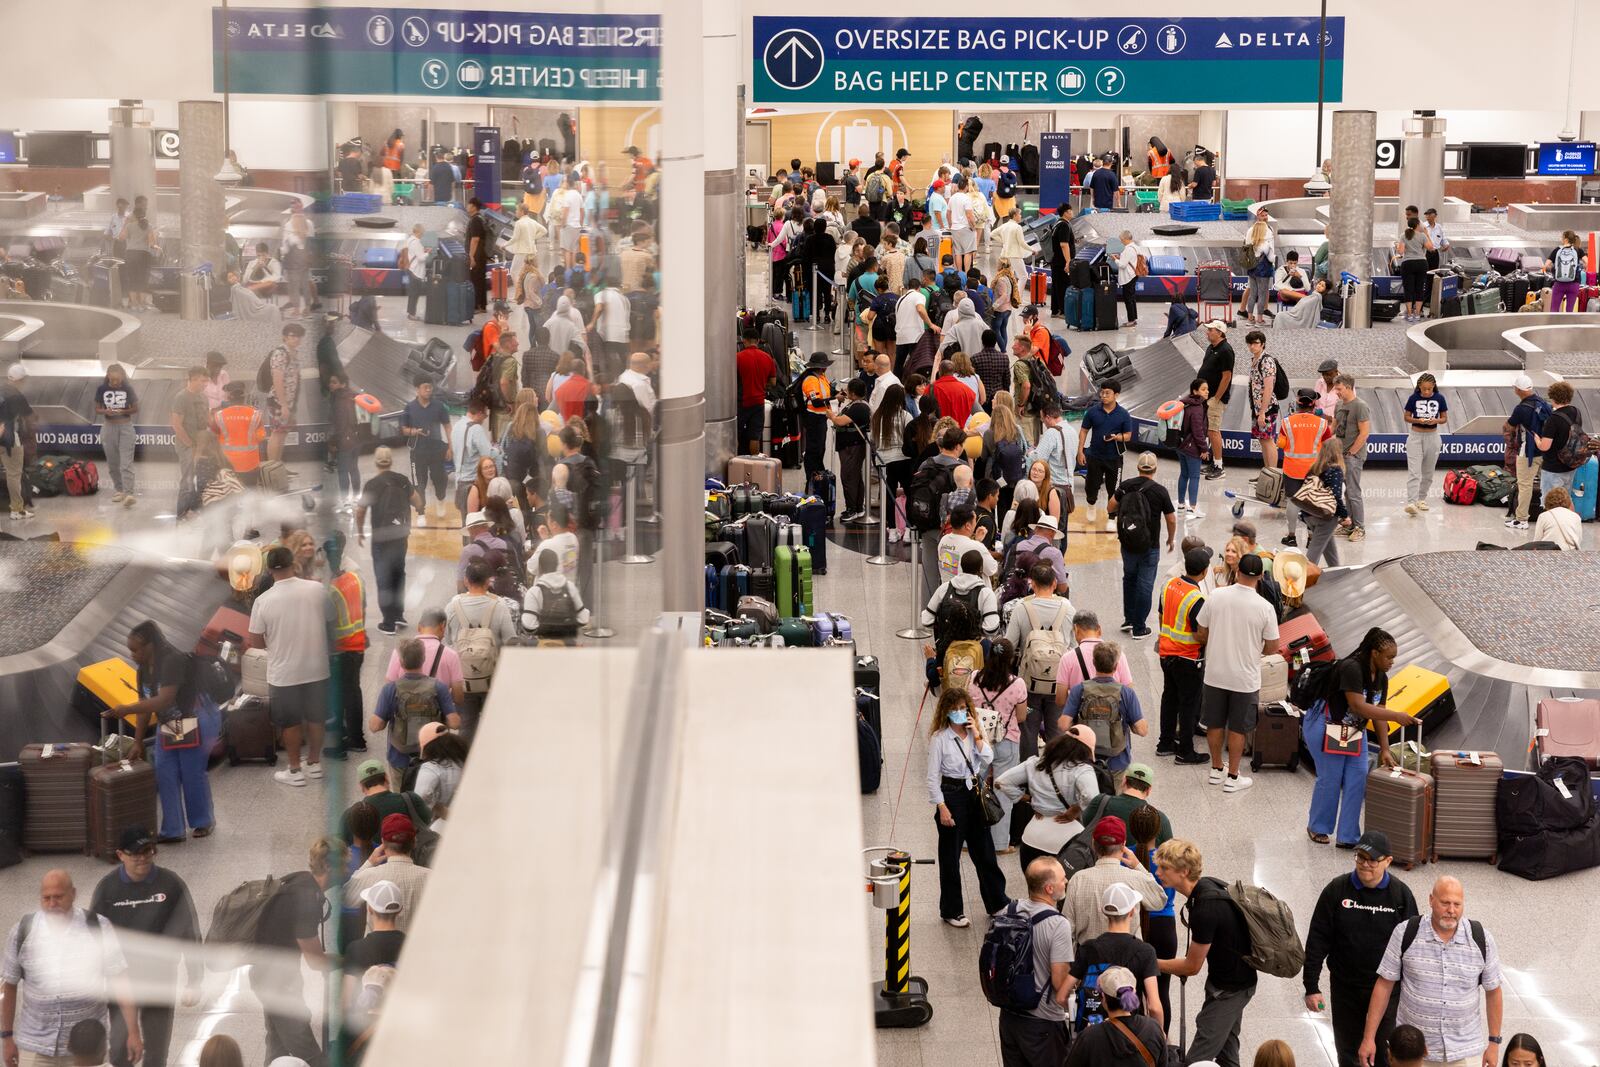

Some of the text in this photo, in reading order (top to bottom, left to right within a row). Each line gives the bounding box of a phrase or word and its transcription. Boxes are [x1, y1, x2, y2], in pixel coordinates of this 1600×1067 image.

[835, 29, 1109, 51] OVERSIZE BAG PICK-UP
[1239, 32, 1310, 47] DELTA
[834, 71, 1048, 92] BAG HELP CENTER
[1377, 142, 1396, 167] 9
[1465, 443, 1485, 454] BAG
[1341, 898, 1396, 914] Champion
